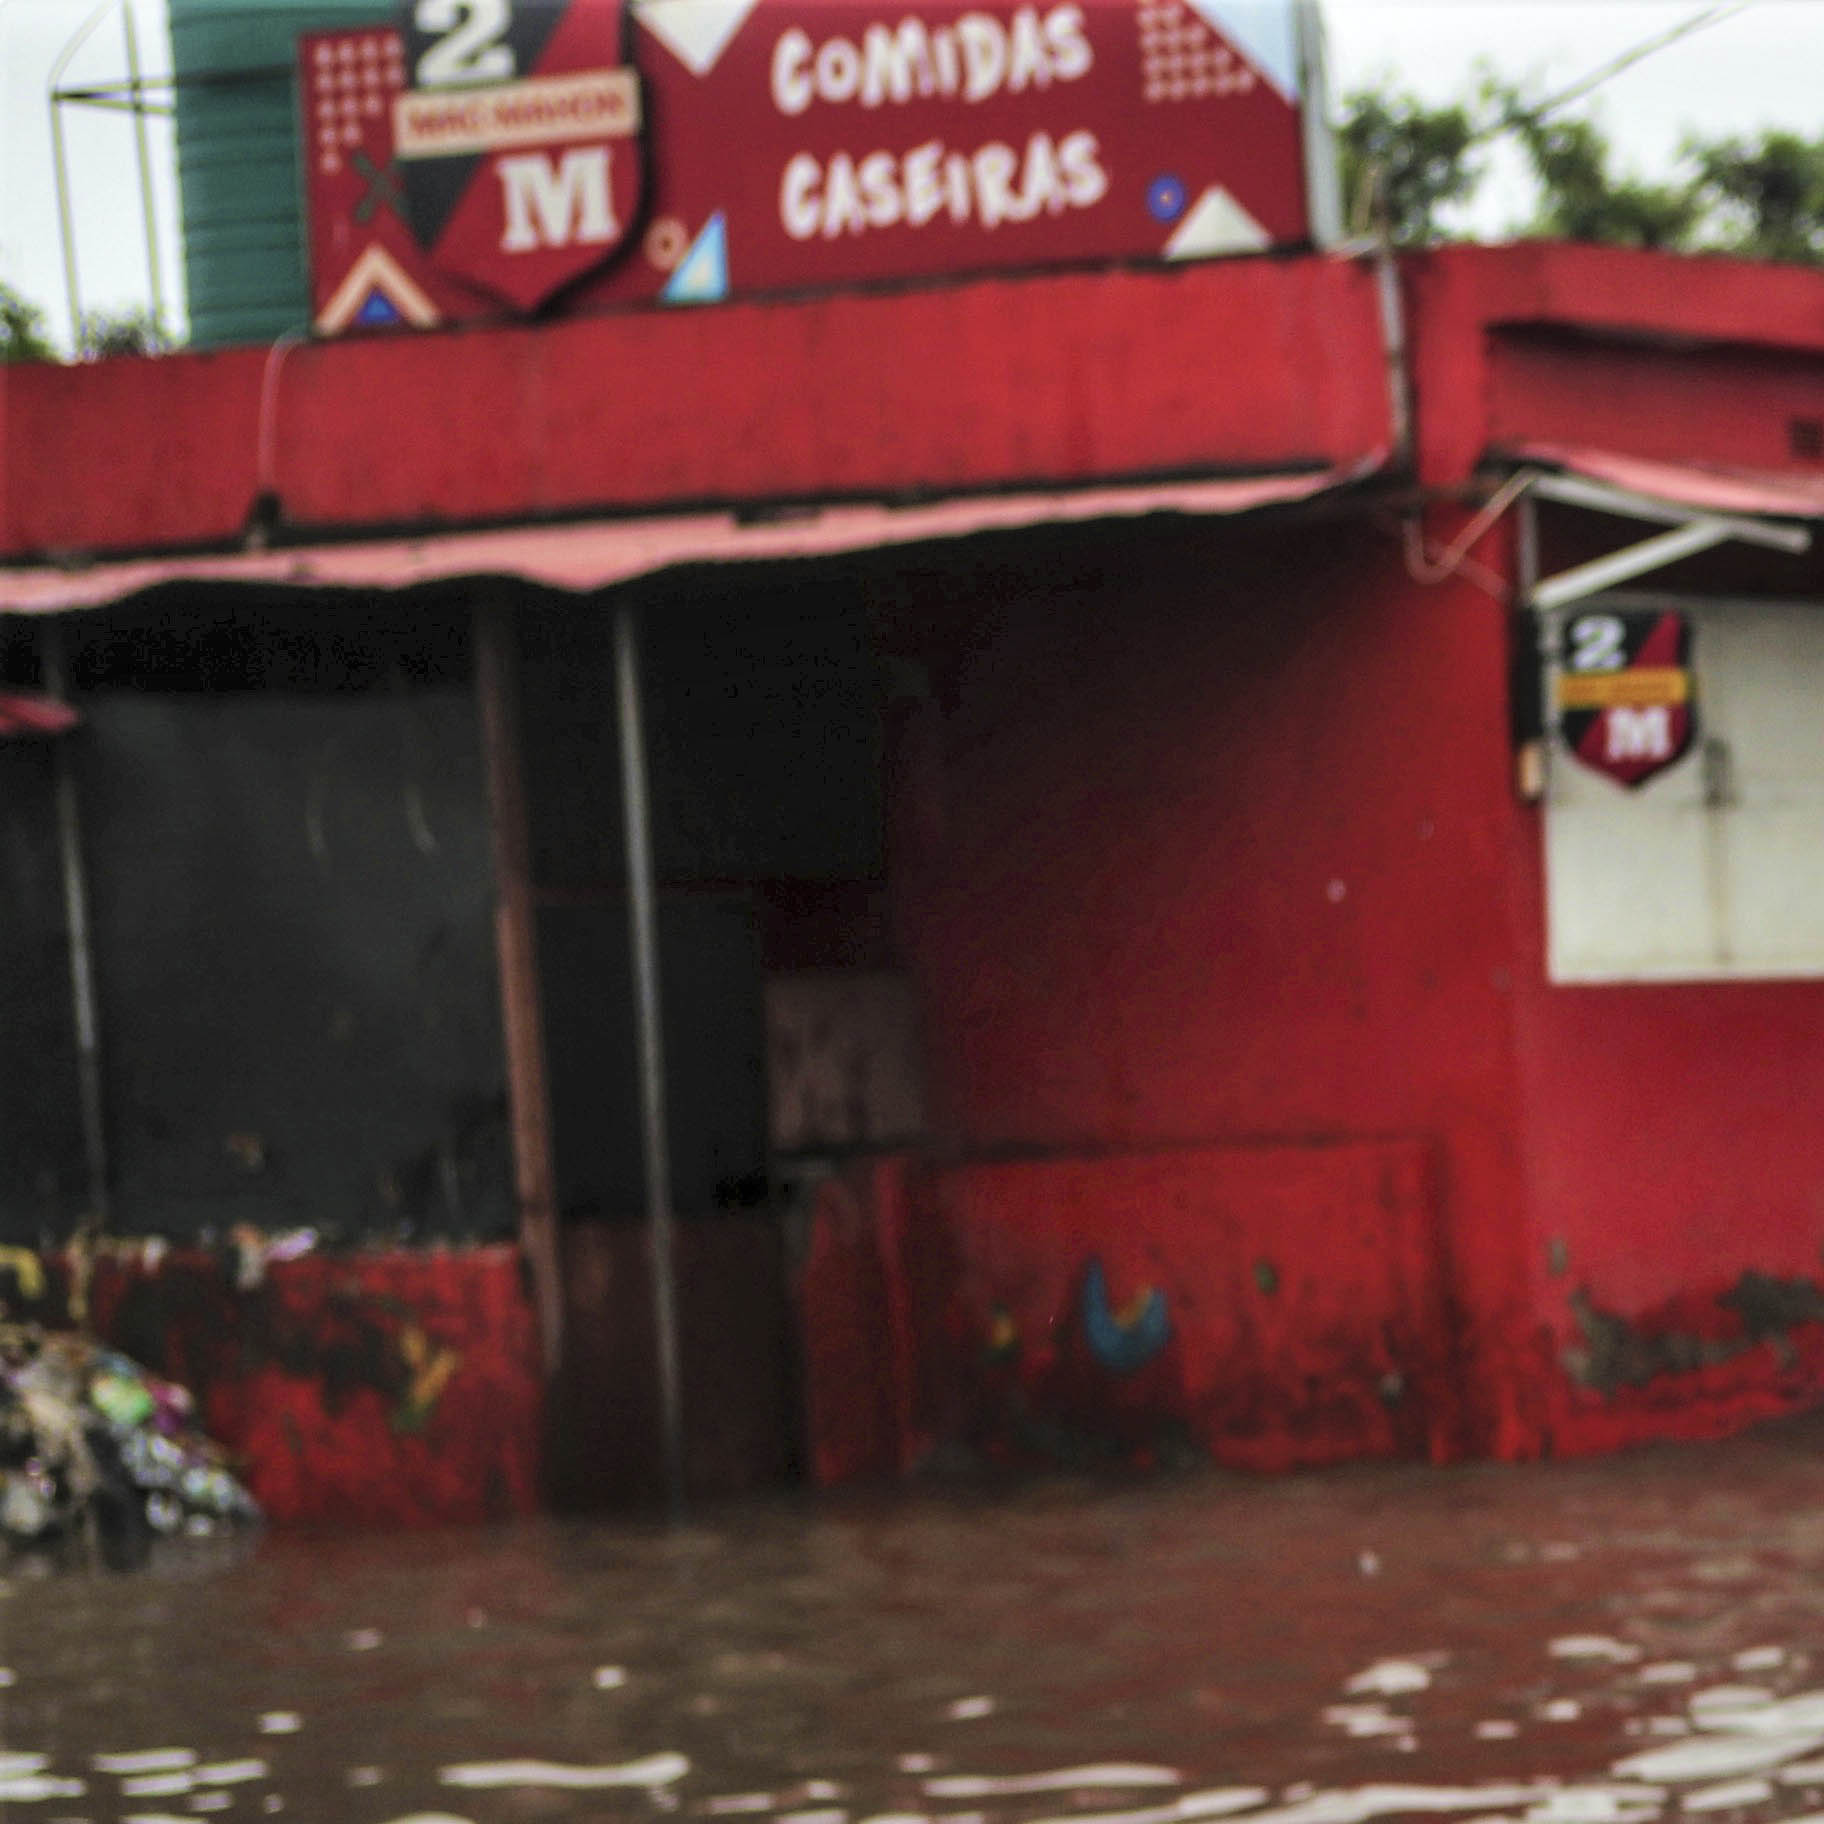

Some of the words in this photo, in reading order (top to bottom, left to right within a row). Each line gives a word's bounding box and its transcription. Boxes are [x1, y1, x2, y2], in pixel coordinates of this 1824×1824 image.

[414, 0, 516, 86] 2
[771, 2, 1094, 116] COMIDAS
[497, 146, 620, 253] M
[780, 129, 1110, 241] CASEIRAS
[1571, 614, 1626, 671] 2
[1605, 706, 1671, 763] M
